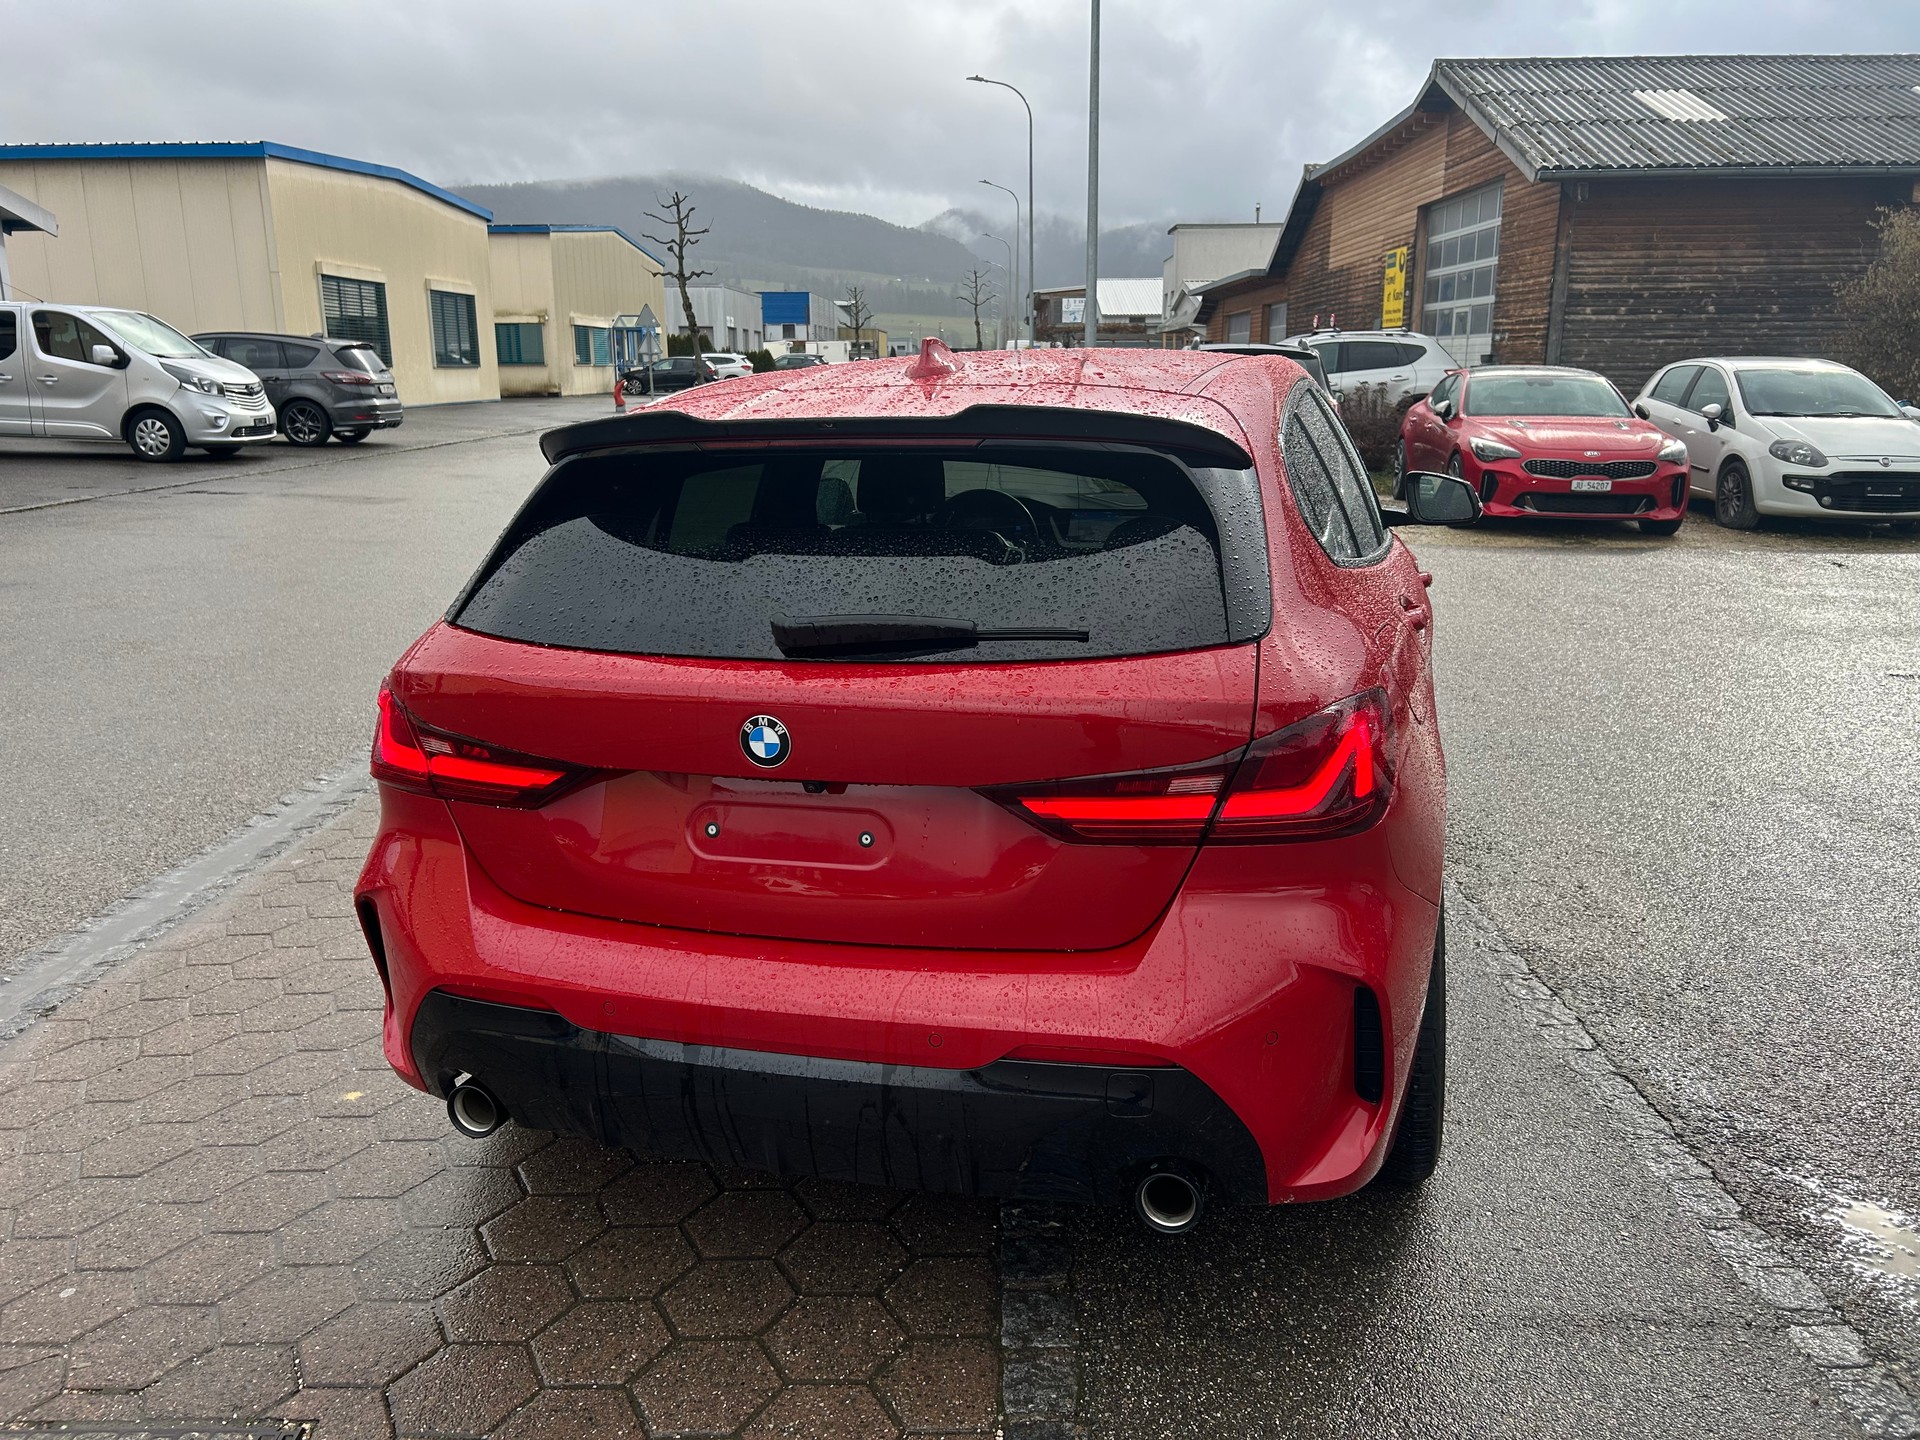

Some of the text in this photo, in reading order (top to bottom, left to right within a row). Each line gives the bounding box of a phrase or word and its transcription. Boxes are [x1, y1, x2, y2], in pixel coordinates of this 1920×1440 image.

[1574, 481, 1610, 490] JU 54207
[744, 717, 785, 735] BMW
